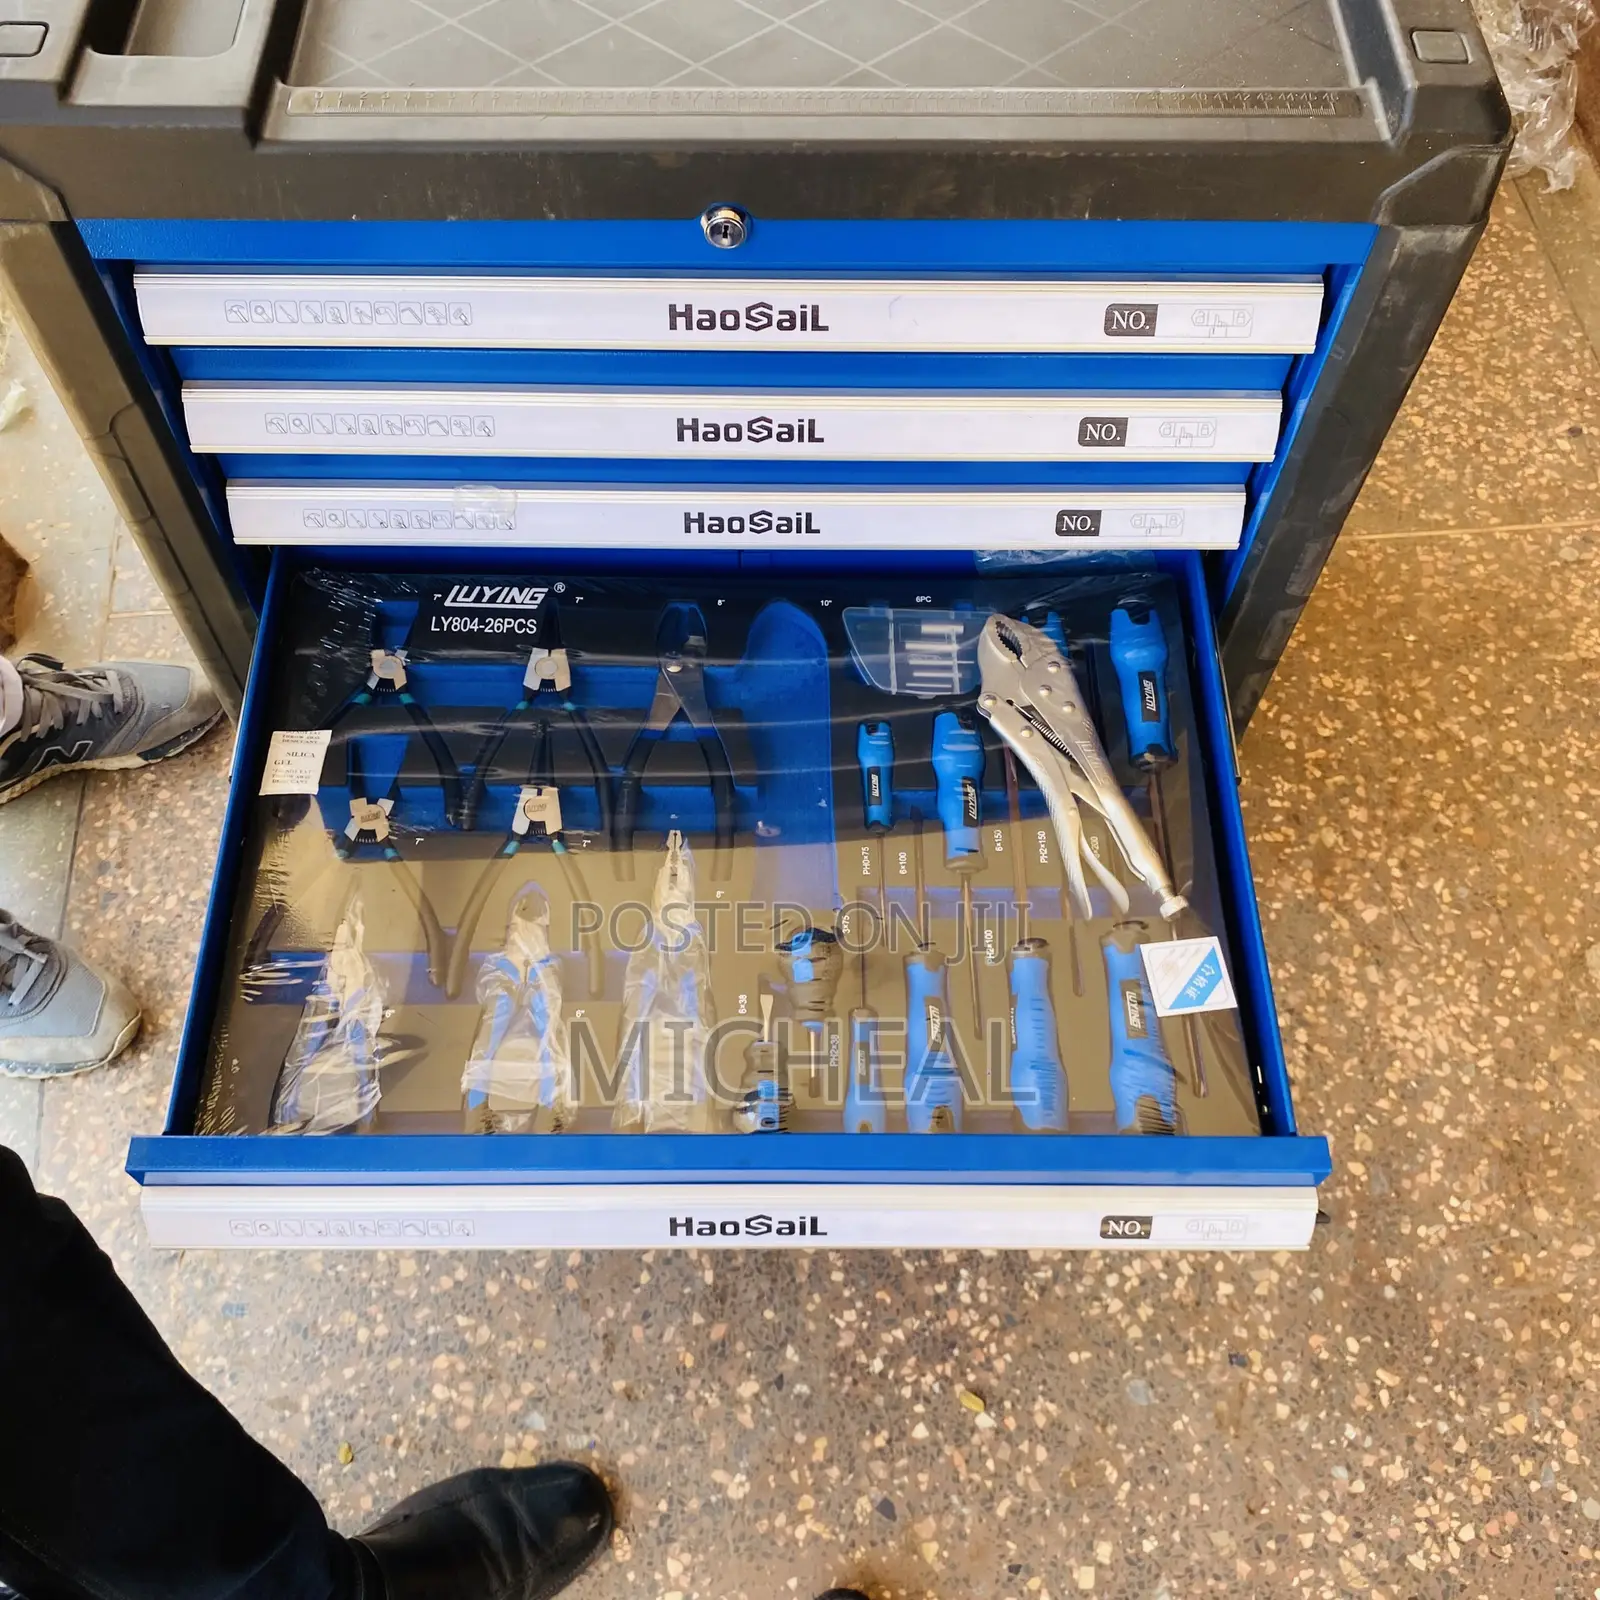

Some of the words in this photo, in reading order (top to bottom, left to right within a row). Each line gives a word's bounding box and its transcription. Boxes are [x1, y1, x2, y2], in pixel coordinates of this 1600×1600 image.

[669, 302, 829, 332] HaoSaiL
[1111, 310, 1150, 330] NO.
[677, 416, 824, 443] HaoSaiL
[1084, 423, 1121, 441] NO.
[684, 511, 820, 535] HaoSaiL
[1061, 515, 1095, 531] NO.
[443, 584, 549, 610] LUYING
[915, 595, 932, 604] 6PC
[430, 615, 538, 635] LY804-26PCS
[1142, 679, 1157, 712] LUYING
[1126, 990, 1141, 1029] LUYING
[669, 1214, 828, 1237] HaoSaiL
[1106, 1220, 1145, 1236] NO.
